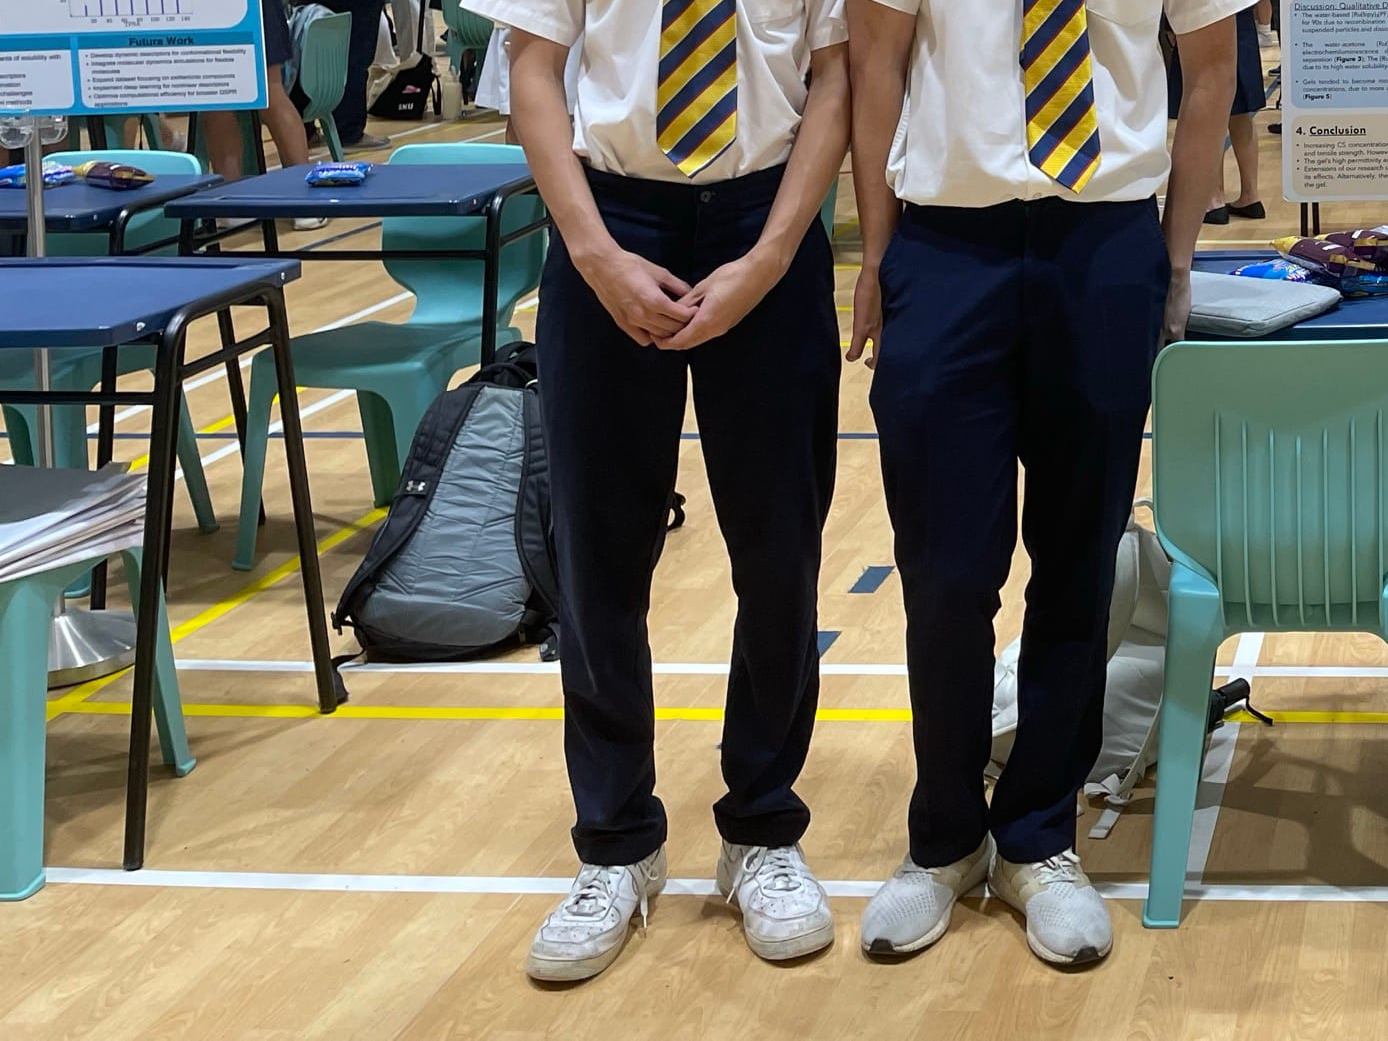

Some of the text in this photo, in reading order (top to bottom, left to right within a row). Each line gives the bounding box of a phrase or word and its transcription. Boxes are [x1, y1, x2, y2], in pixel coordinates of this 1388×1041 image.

[1294, 2, 1338, 11] Discussion:
[1340, 1, 1381, 10] Qualitative
[128, 35, 194, 46] Future Work
[1295, 126, 1366, 136] 4. Conclusion
